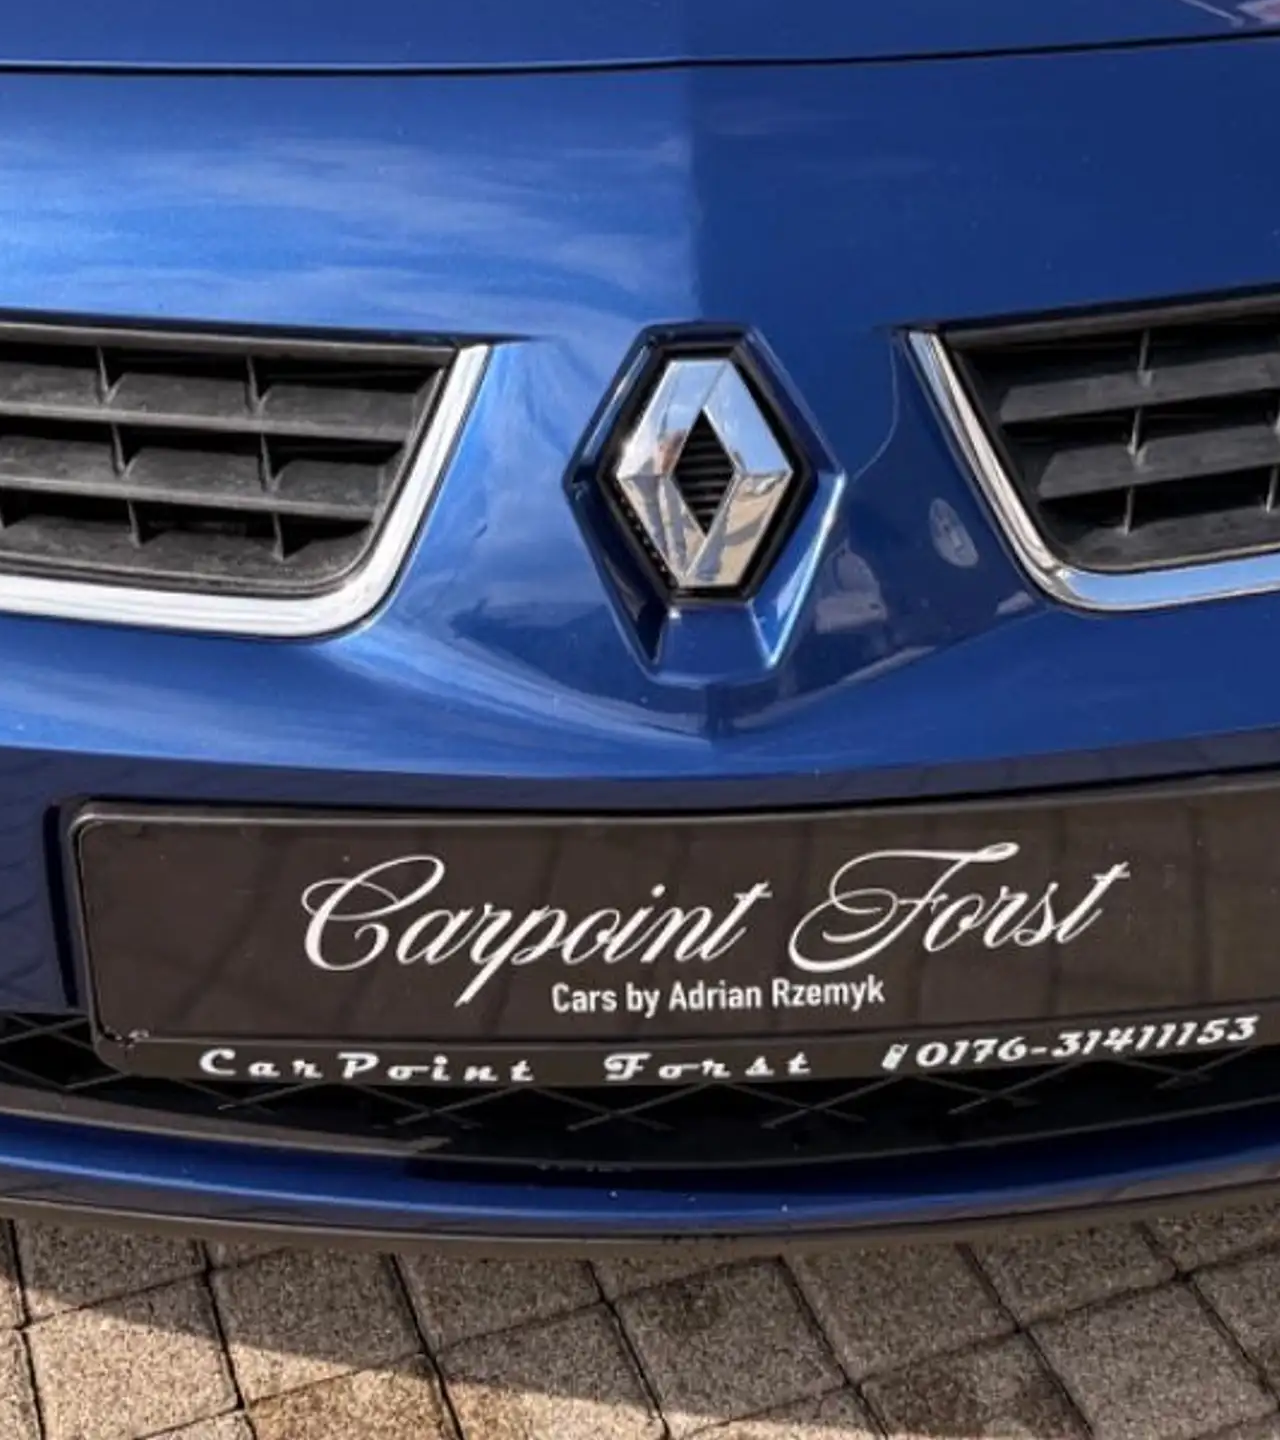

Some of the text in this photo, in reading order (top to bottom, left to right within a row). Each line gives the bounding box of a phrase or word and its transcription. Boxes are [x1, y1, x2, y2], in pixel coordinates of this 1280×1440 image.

[301, 842, 1130, 1007] Carpoint Forst
[551, 973, 886, 1019] Cars by Adrian Rzemyk
[603, 1051, 811, 1081] Forst
[915, 1015, 1260, 1068] 0176-31411153
